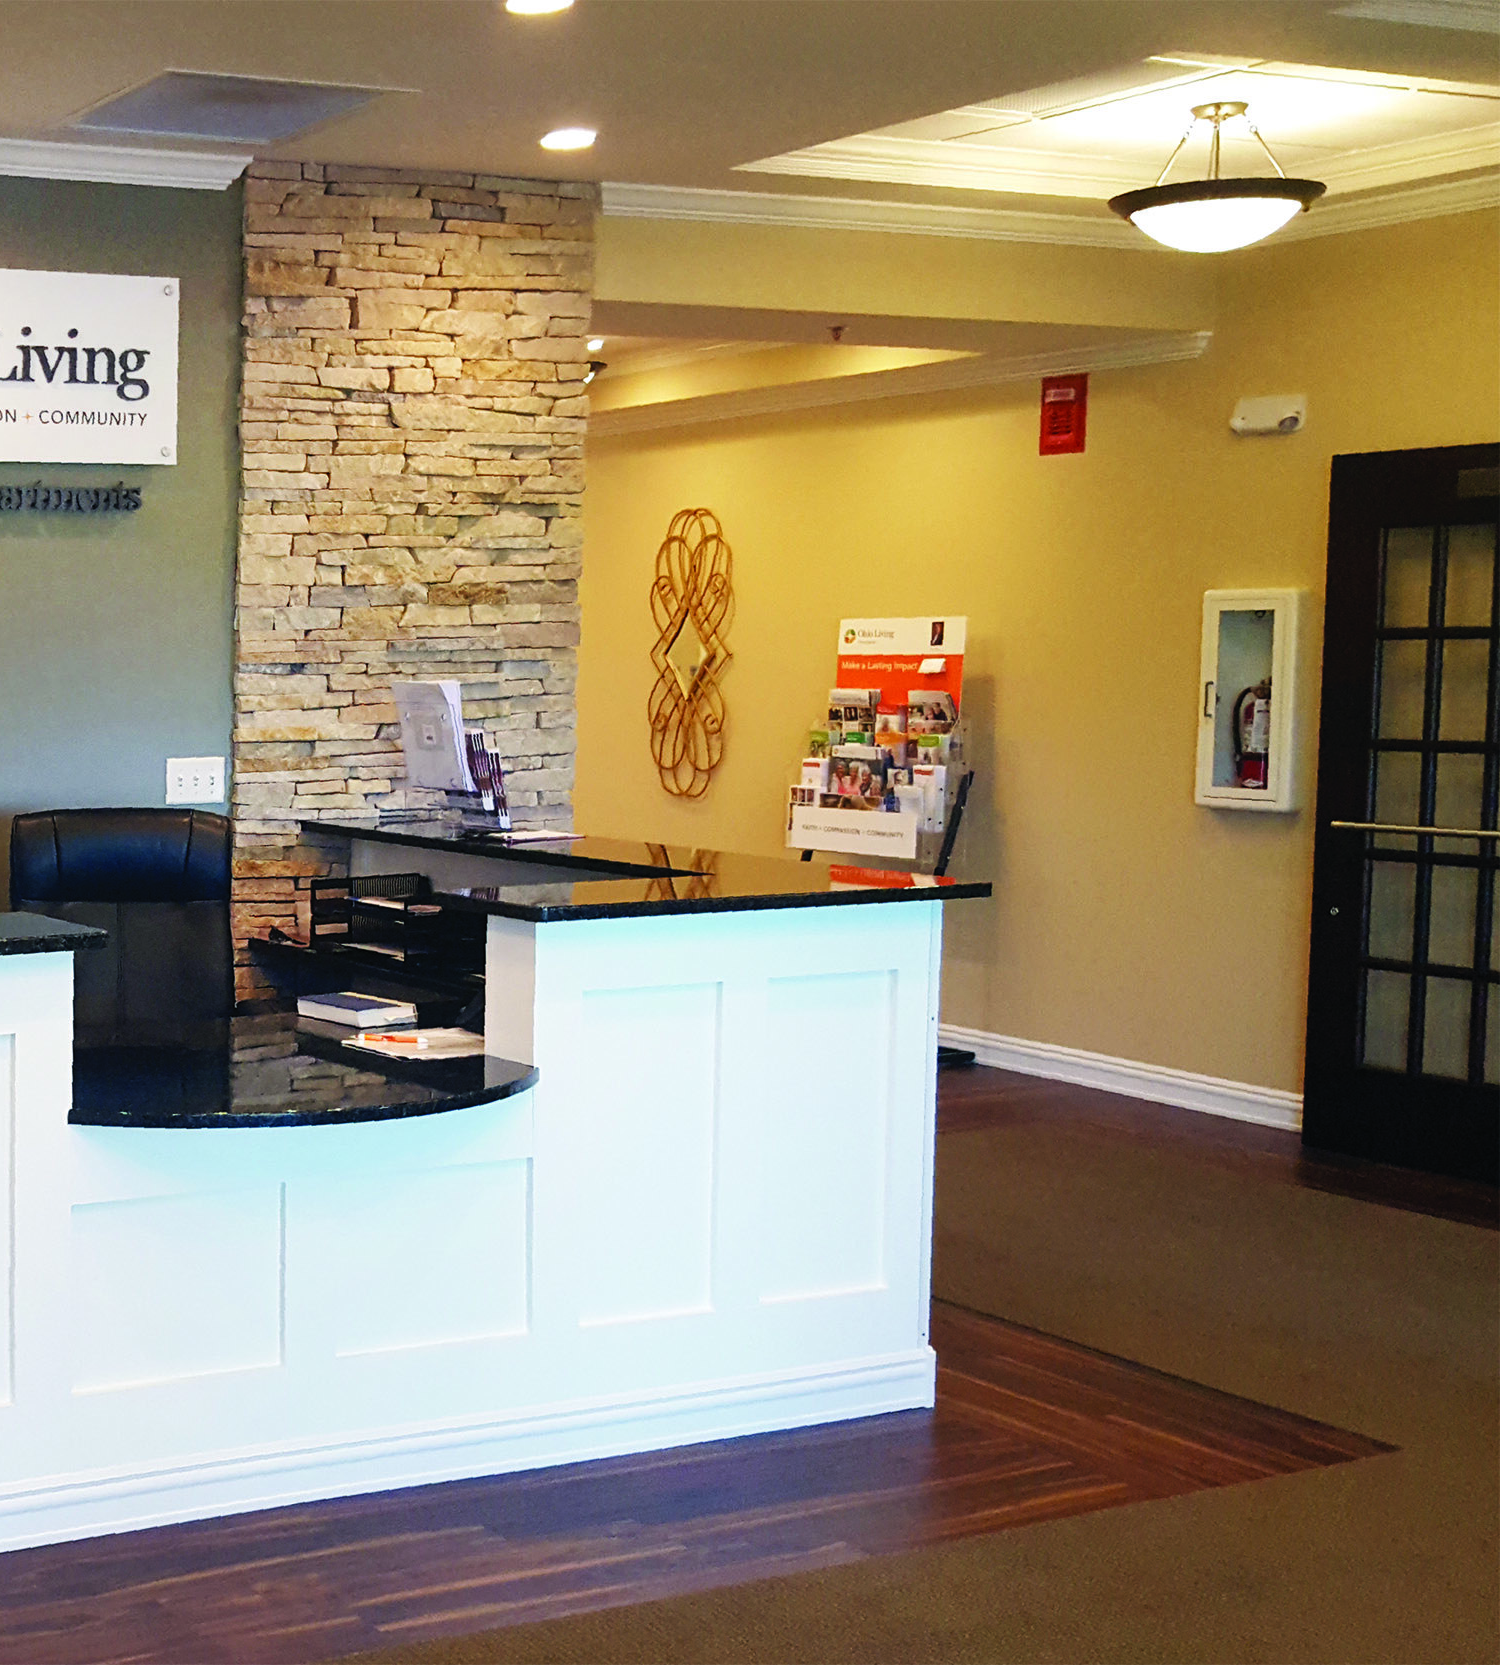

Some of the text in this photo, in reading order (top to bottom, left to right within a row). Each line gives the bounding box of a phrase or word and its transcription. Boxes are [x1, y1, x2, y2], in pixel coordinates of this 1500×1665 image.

[38, 410, 148, 426] COMMUNITY
[841, 661, 860, 670] Make
[867, 661, 892, 673] Lasting
[893, 661, 918, 673] Impact
